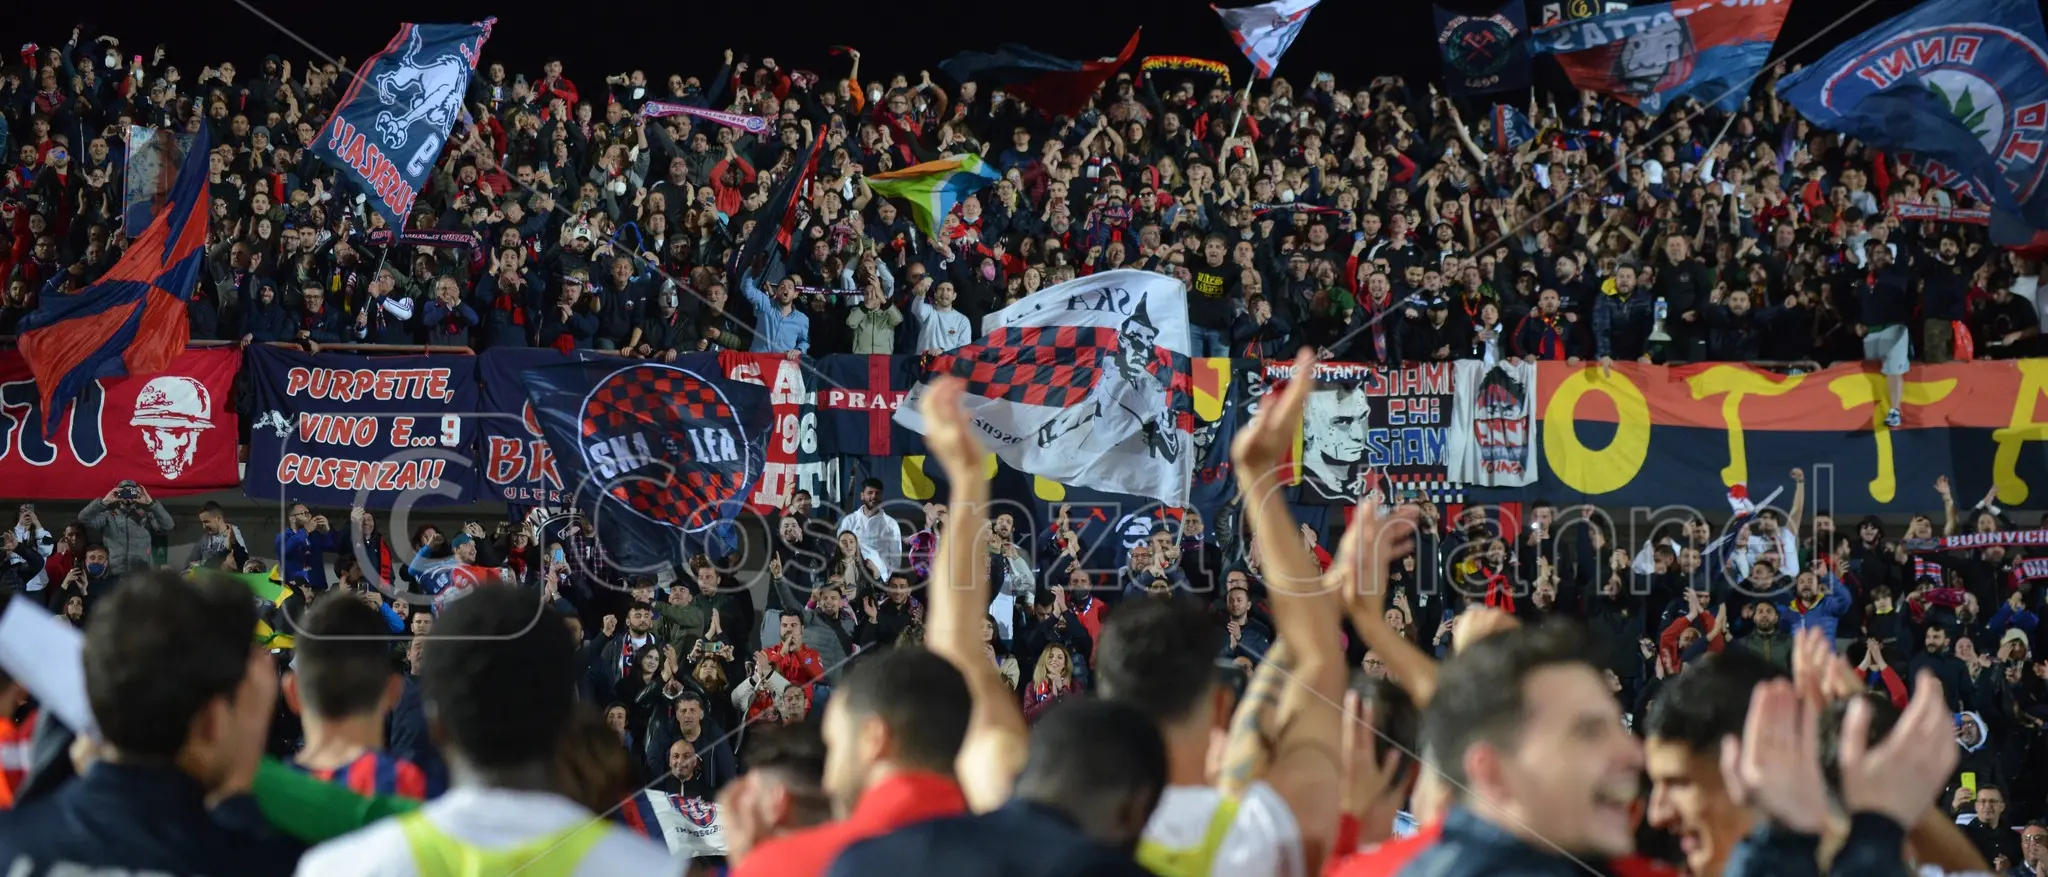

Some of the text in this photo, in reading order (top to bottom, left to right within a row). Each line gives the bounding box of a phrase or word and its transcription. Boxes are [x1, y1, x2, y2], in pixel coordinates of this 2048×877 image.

[286, 366, 455, 404] PURPETTE,
[829, 390, 905, 411] PRAJ
[299, 411, 379, 448] VINO
[276, 452, 446, 491] CUSENZA!!
[589, 427, 739, 479] SKA LEA
